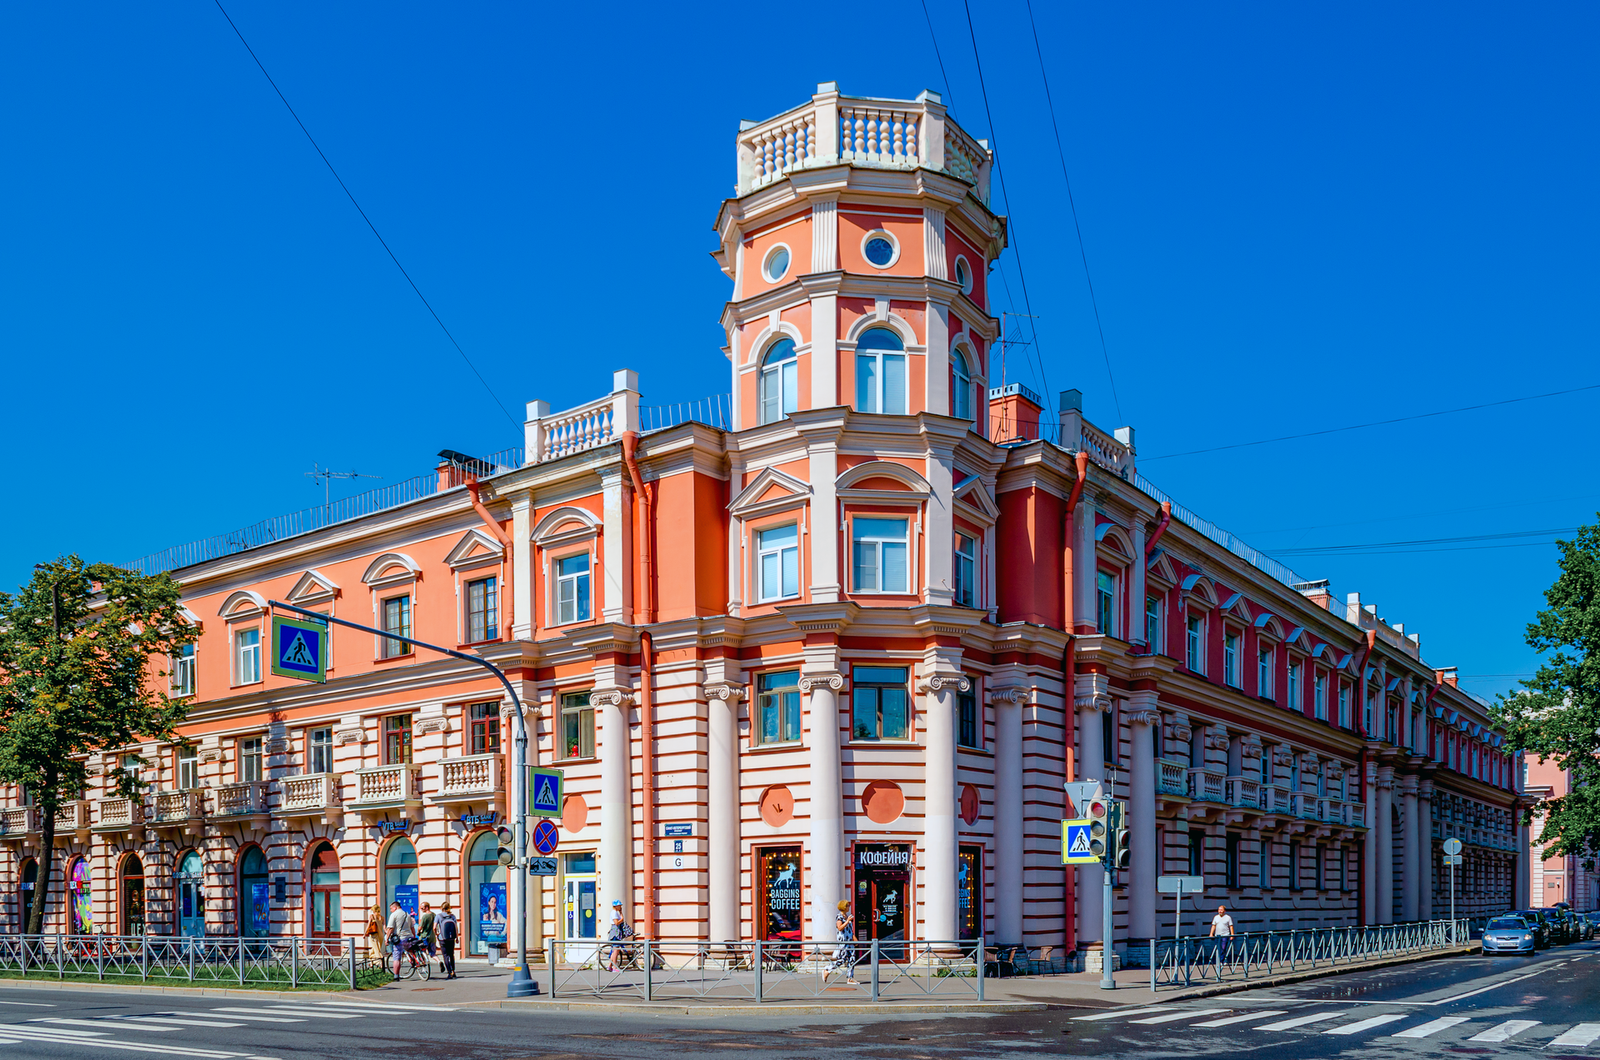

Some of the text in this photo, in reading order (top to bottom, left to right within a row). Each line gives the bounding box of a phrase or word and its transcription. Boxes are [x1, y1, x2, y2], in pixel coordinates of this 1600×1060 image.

[466, 815, 479, 824] ВТБ
[860, 850, 908, 865] КОФЕЙНЯ
[675, 858, 682, 868] G
[770, 889, 800, 898] BAGGINS
[770, 898, 800, 910] COFFEE
